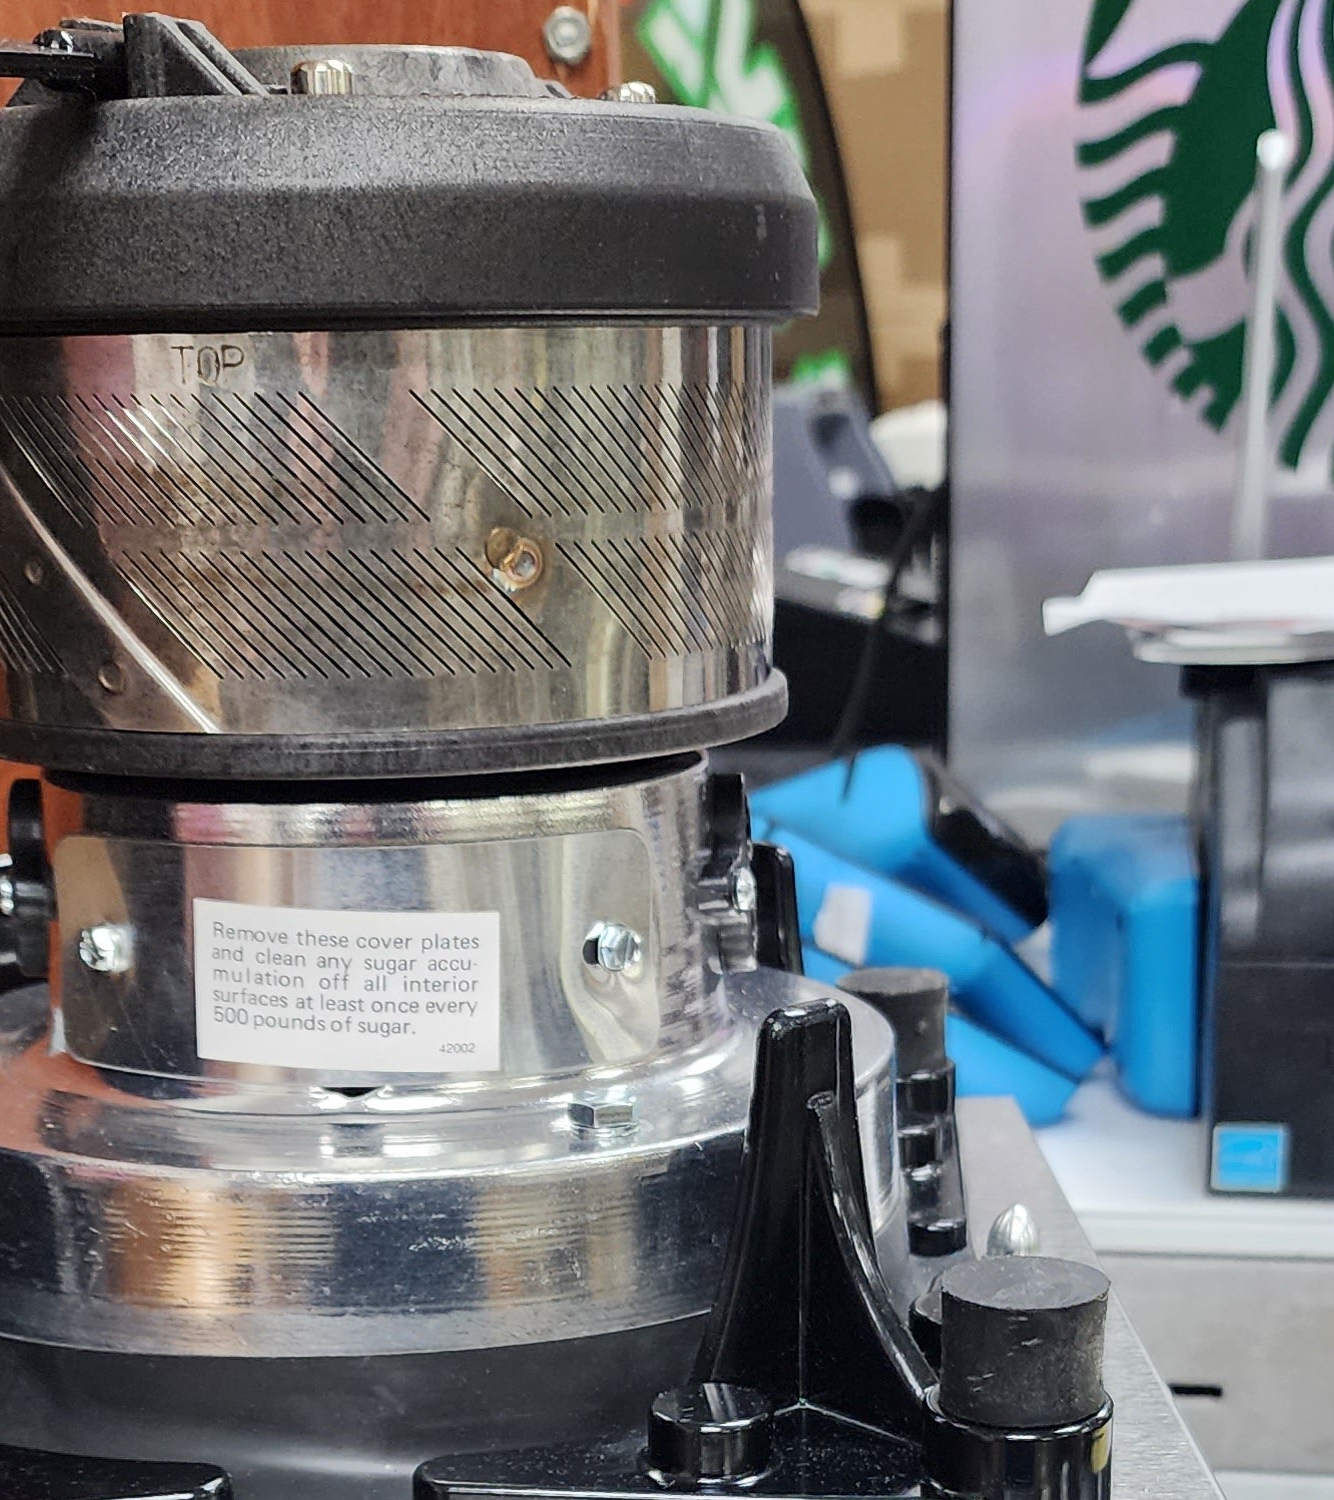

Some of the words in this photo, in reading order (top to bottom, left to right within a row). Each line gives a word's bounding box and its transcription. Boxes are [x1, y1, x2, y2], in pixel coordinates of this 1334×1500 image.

[170, 344, 244, 386] TOP
[212, 921, 289, 946] Remove
[296, 931, 349, 949] these
[356, 935, 413, 951] cover
[421, 934, 480, 954] plates
[212, 945, 244, 963] and
[255, 950, 306, 968] clean
[316, 954, 353, 972] any
[363, 957, 417, 976] sugar
[426, 957, 479, 973] accu-
[212, 966, 305, 989] mulation
[319, 973, 350, 991] off
[363, 975, 388, 992] all
[402, 975, 479, 993] interior
[212, 988, 289, 1009] surfaces
[295, 994, 314, 1011] at
[319, 995, 365, 1013] least
[370, 998, 420, 1015] once
[424, 1001, 478, 1017] every
[213, 1006, 249, 1026] 500
[253, 1012, 327, 1033] pounds
[330, 1015, 353, 1033] of
[357, 1019, 417, 1039] sugar.
[438, 1043, 476, 1055] 42002
